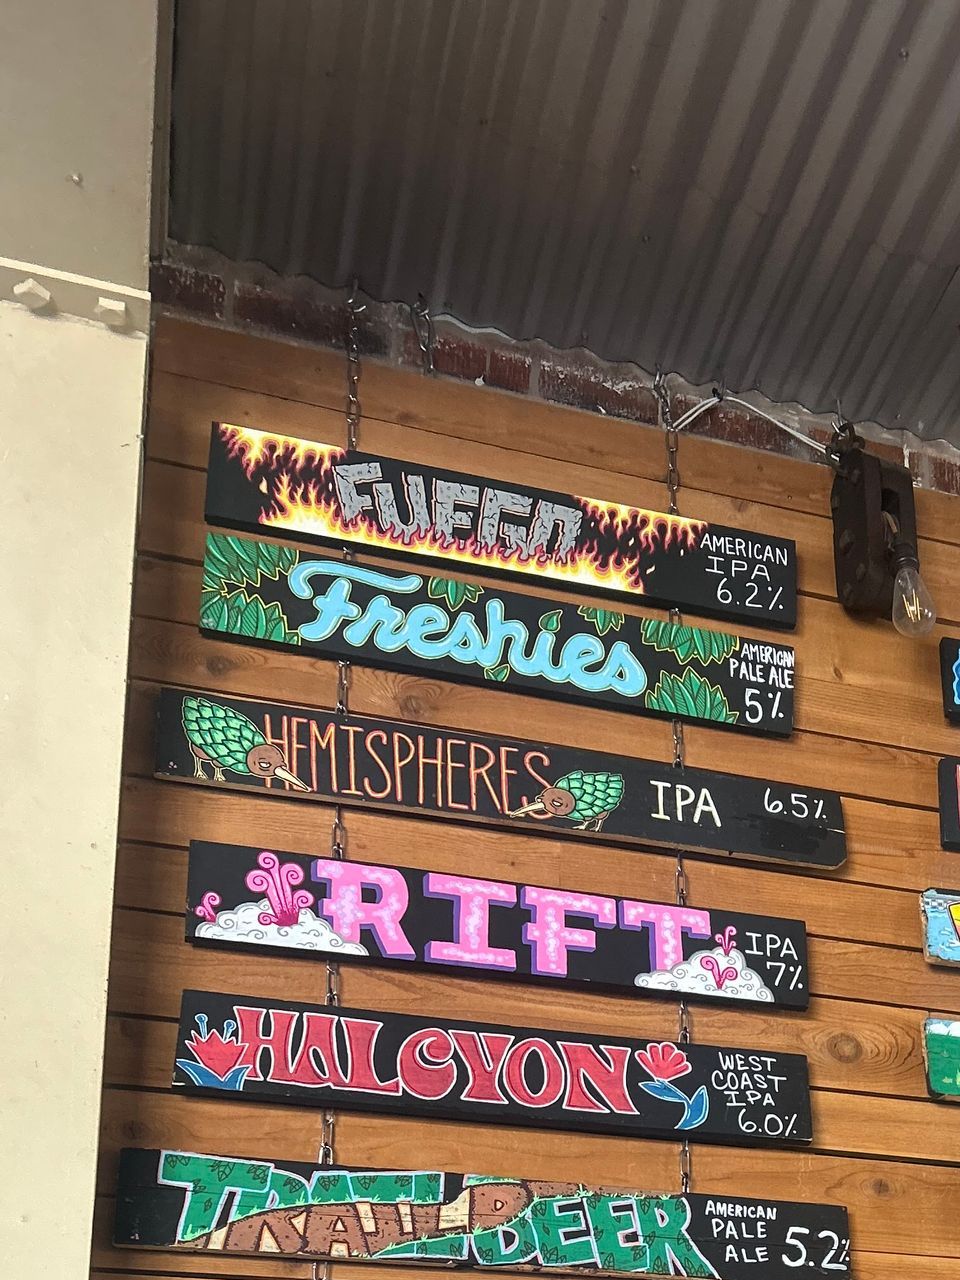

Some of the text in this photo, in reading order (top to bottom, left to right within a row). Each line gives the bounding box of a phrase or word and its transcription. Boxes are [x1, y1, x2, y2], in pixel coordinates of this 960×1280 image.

[332, 461, 583, 564] FUEGO
[700, 533, 788, 566] AMERICAN
[705, 555, 771, 582] IPA
[716, 578, 784, 610] 6.2%
[287, 560, 647, 696] Freshies
[740, 643, 795, 667] AMERICAN
[729, 658, 795, 689] PALE ALE
[744, 688, 784, 723] 5%
[263, 713, 558, 820] HEMISPHERES
[650, 780, 827, 827] IPA 6.5%
[312, 859, 712, 976] RIFT
[745, 932, 799, 960] IPA
[766, 961, 804, 990] 7%
[233, 1006, 640, 1115] HALCYON
[718, 1051, 777, 1072] WEST
[711, 1071, 787, 1092] COAST
[724, 1090, 776, 1107] IPA
[738, 1108, 798, 1137] 6.0%
[705, 1200, 777, 1220] AMERICAN
[711, 1218, 767, 1239] PALE
[725, 1244, 769, 1263] ALE
[781, 1226, 850, 1271] 5.2%
